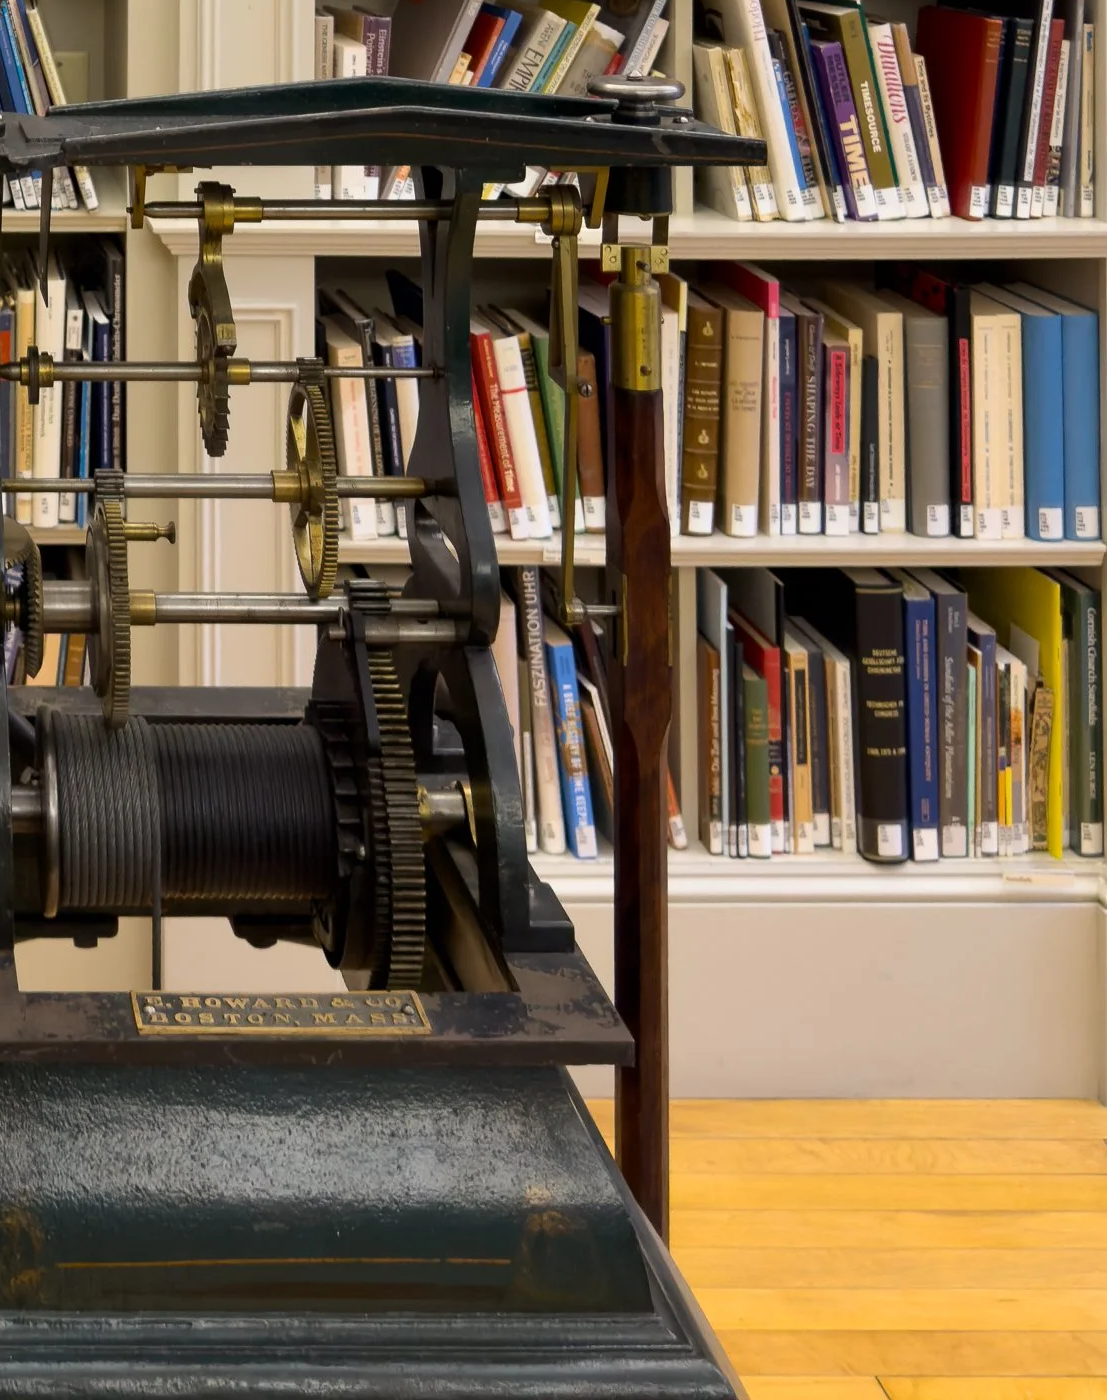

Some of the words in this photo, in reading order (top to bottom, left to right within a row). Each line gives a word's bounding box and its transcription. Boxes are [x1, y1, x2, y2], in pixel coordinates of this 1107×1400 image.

[376, 29, 387, 73] Einstein's
[833, 52, 849, 102] BUTLER
[877, 39, 908, 124] Durations
[859, 80, 882, 153] TIMESOURCE
[916, 60, 924, 76] Time
[923, 103, 934, 138] Mysteries
[839, 113, 869, 188] TIME
[489, 383, 499, 399] The
[805, 375, 816, 432] SHAPING
[492, 400, 509, 456] Measurement
[501, 456, 511, 469] of
[805, 436, 815, 462] THE
[503, 469, 515, 492] Time
[804, 466, 814, 488] DAY
[522, 570, 536, 604] UHR
[1086, 607, 1096, 645] Cornish
[525, 608, 547, 706] FASZINATION
[943, 656, 953, 693] Sundials
[1087, 646, 1097, 682] Church
[944, 705, 952, 717] the
[1088, 684, 1097, 725] Sundials
[944, 721, 953, 742] Adler
[944, 745, 954, 798] Planetarium
[148, 1012, 301, 1027] BOSTON,
[312, 1012, 417, 1026] MASS.
[179, 996, 319, 1010] HOWARD
[331, 996, 354, 1009] &
